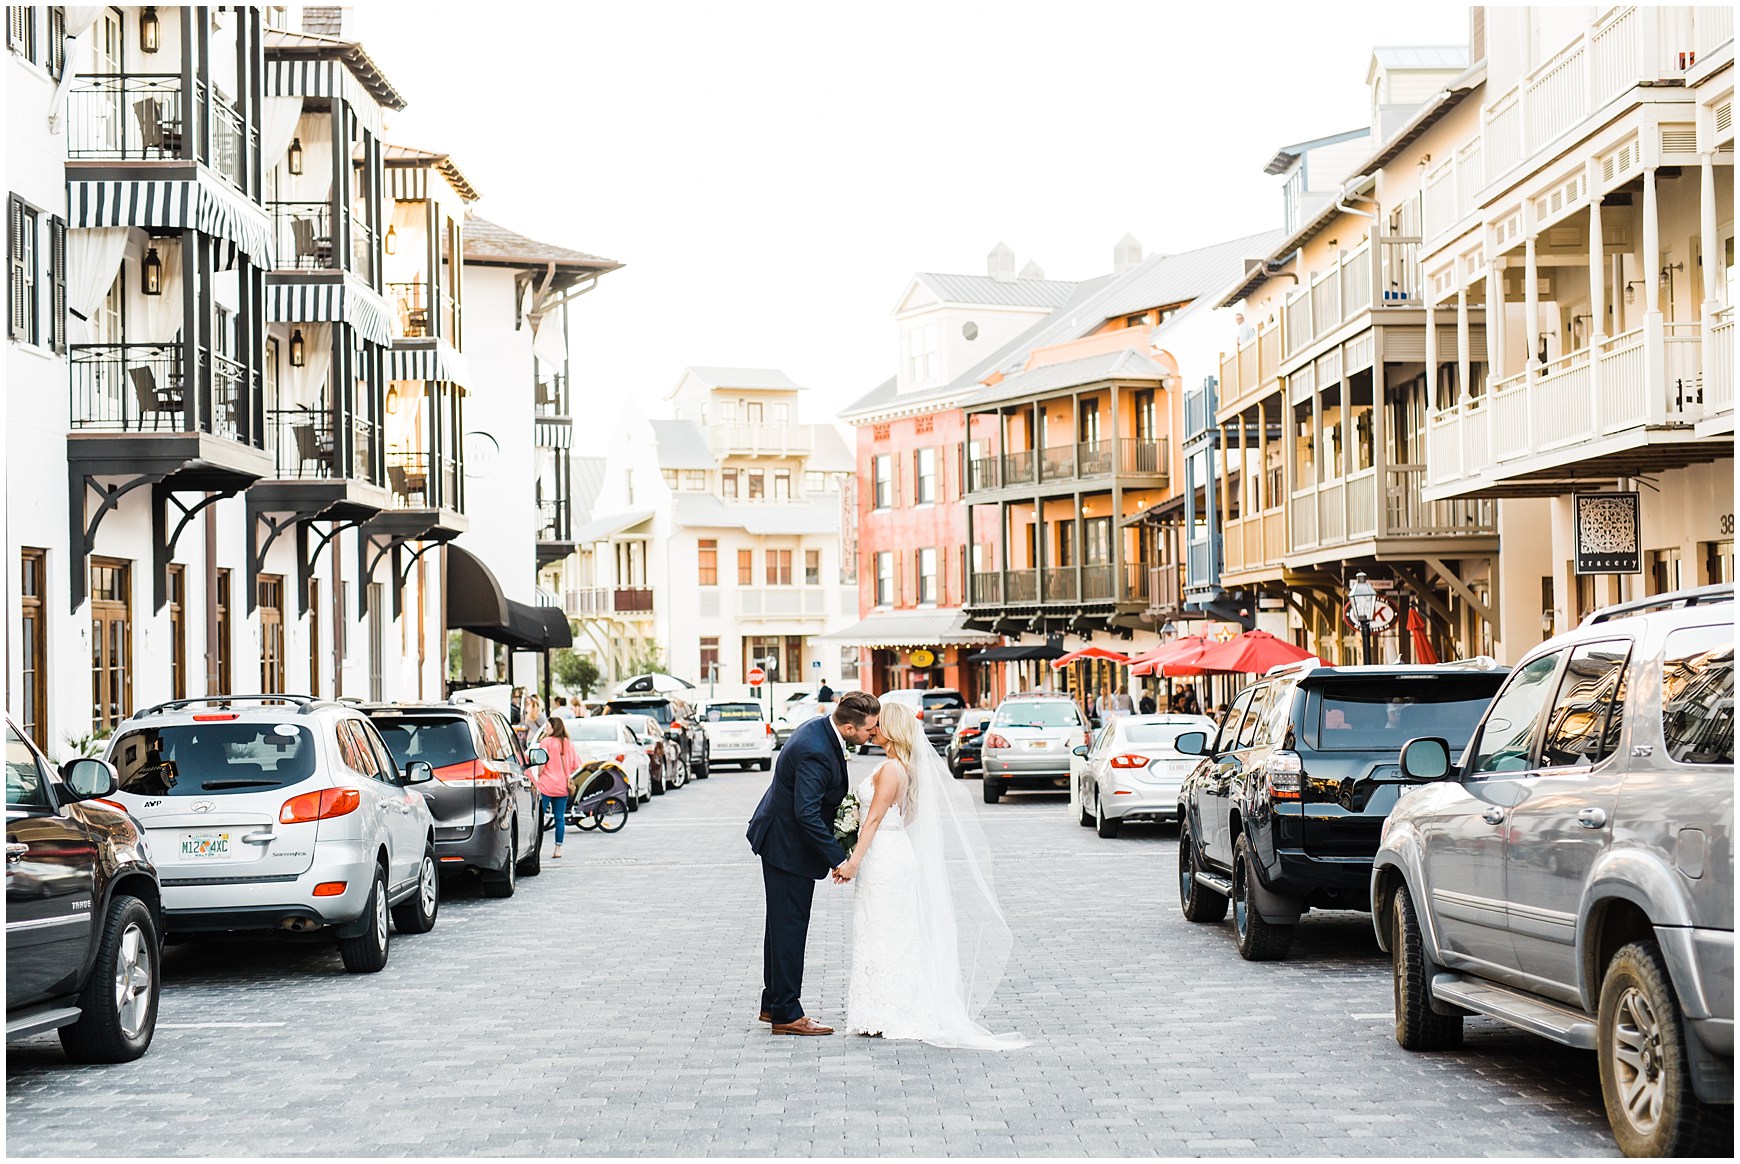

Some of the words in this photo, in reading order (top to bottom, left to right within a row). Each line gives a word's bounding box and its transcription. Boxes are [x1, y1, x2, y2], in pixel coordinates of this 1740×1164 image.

[844, 486, 852, 567] PENSIONE
[1580, 559, 1637, 568] tracery
[71, 899, 91, 910] TAHOE
